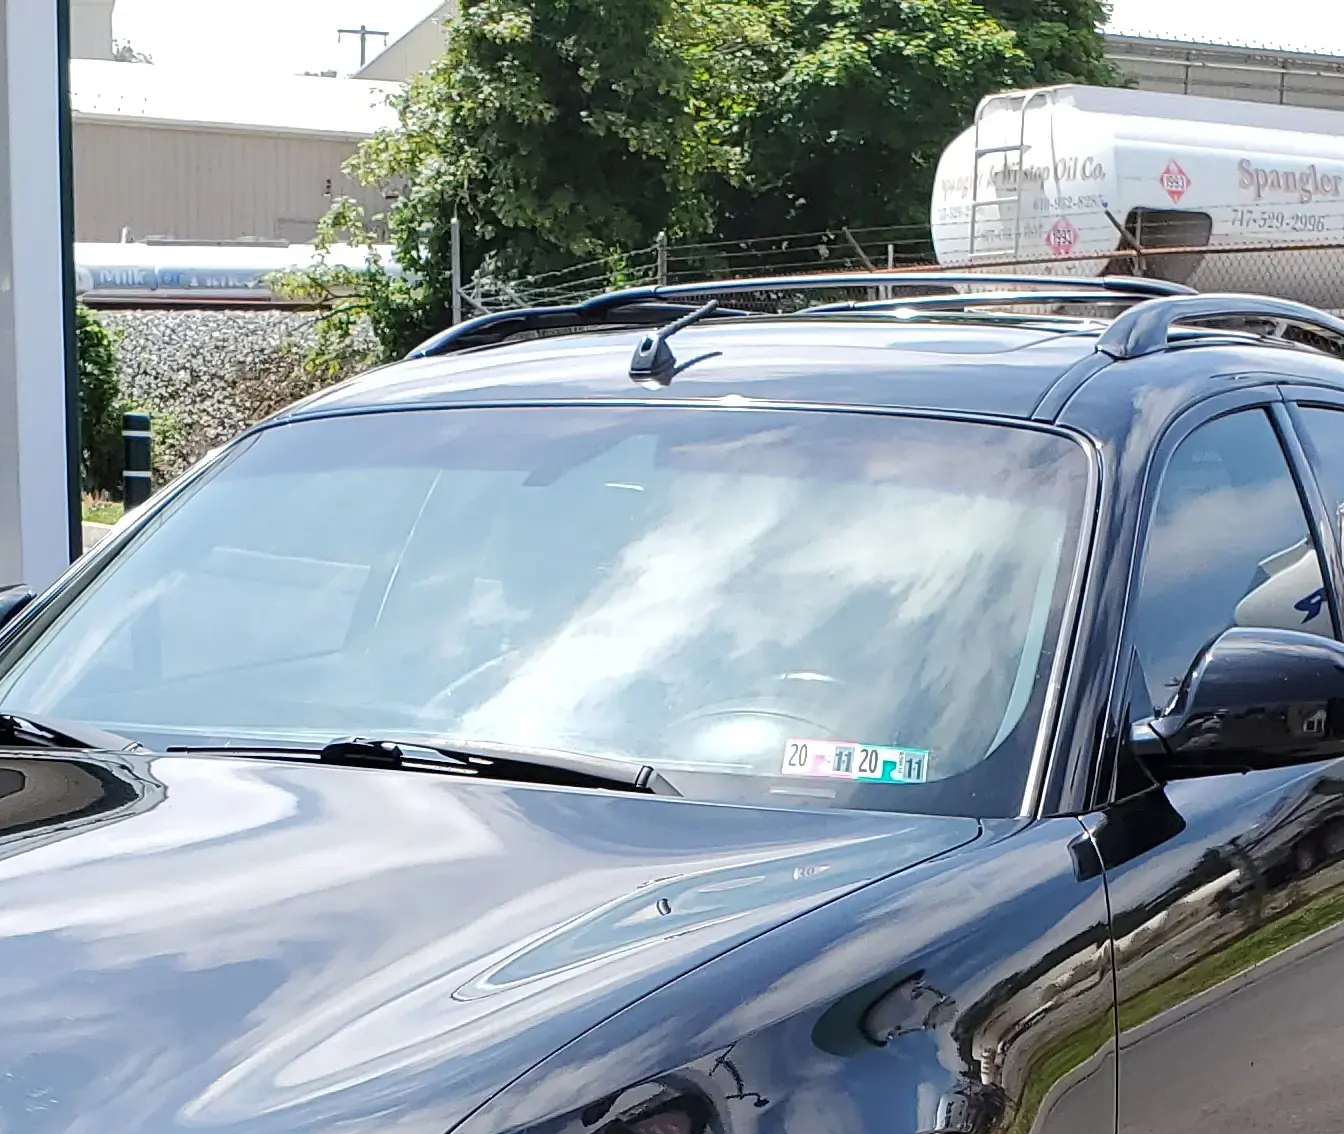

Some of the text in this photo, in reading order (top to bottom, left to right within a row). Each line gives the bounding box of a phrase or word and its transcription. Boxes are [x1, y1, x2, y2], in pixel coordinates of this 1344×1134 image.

[1056, 157, 1078, 181] Oil
[1237, 158, 1343, 203] Spangler
[1231, 208, 1325, 233] 717-529-2996
[788, 743, 852, 773] 20 11
[858, 748, 878, 774] 20
[906, 757, 924, 780] 11
